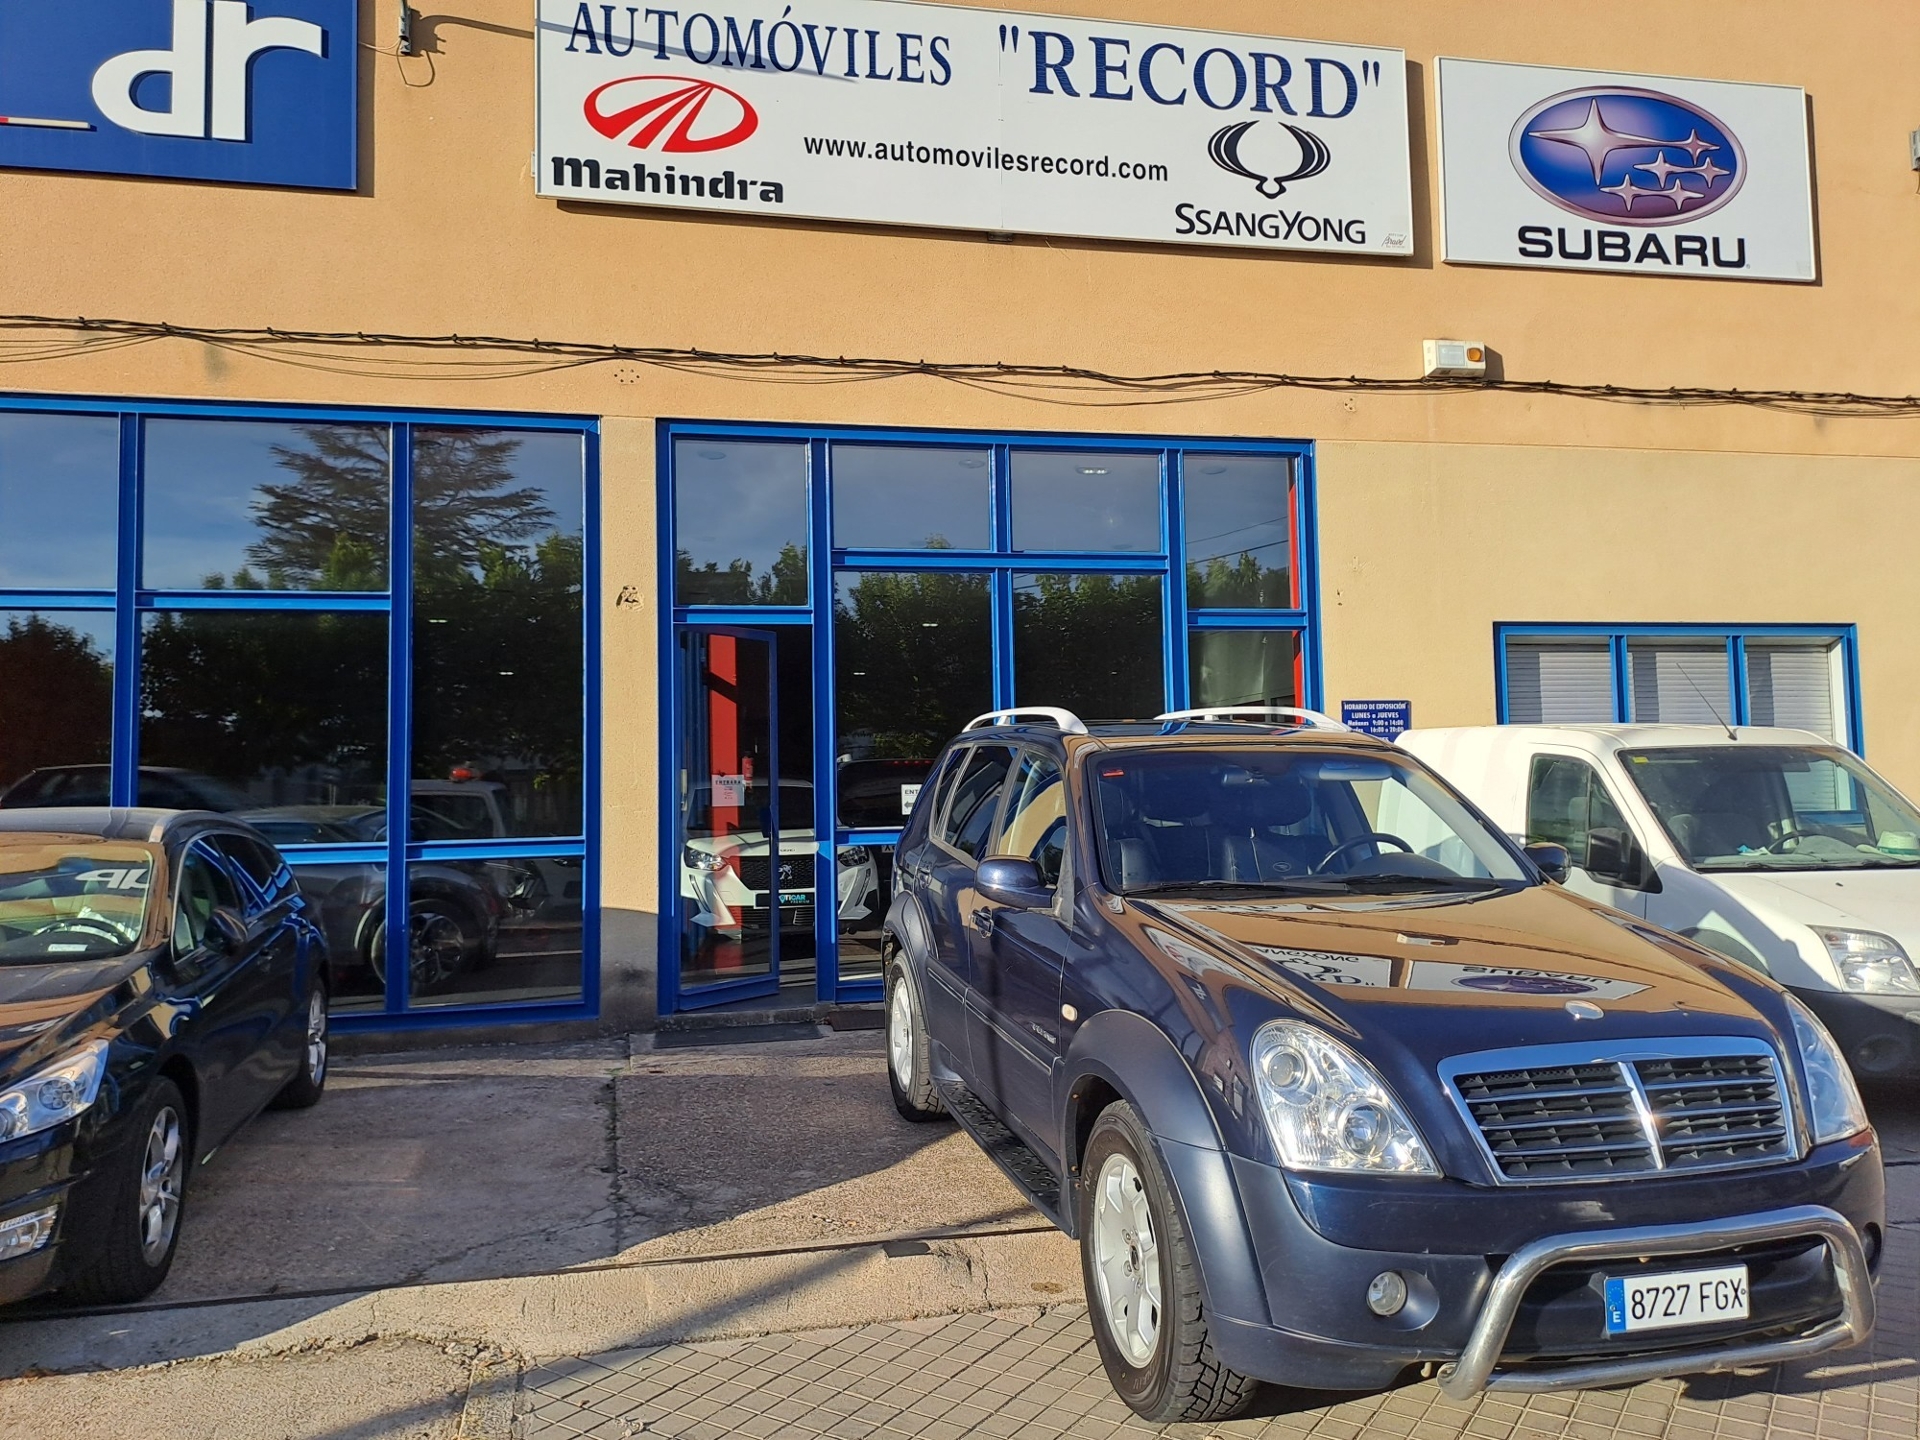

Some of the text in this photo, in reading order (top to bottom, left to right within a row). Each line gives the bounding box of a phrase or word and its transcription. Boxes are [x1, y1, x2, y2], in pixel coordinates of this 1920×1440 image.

[92, 0, 322, 141] dr
[565, 2, 1381, 119] AUTOMÓVILES "RECORD"
[803, 136, 1169, 182] www.automovilesrecord.com
[1517, 225, 1746, 269] SUBARU
[1351, 711, 1371, 719] LUNES
[1377, 711, 1399, 719] JUEVES
[1612, 1277, 1743, 1323] E 8727 FGX
